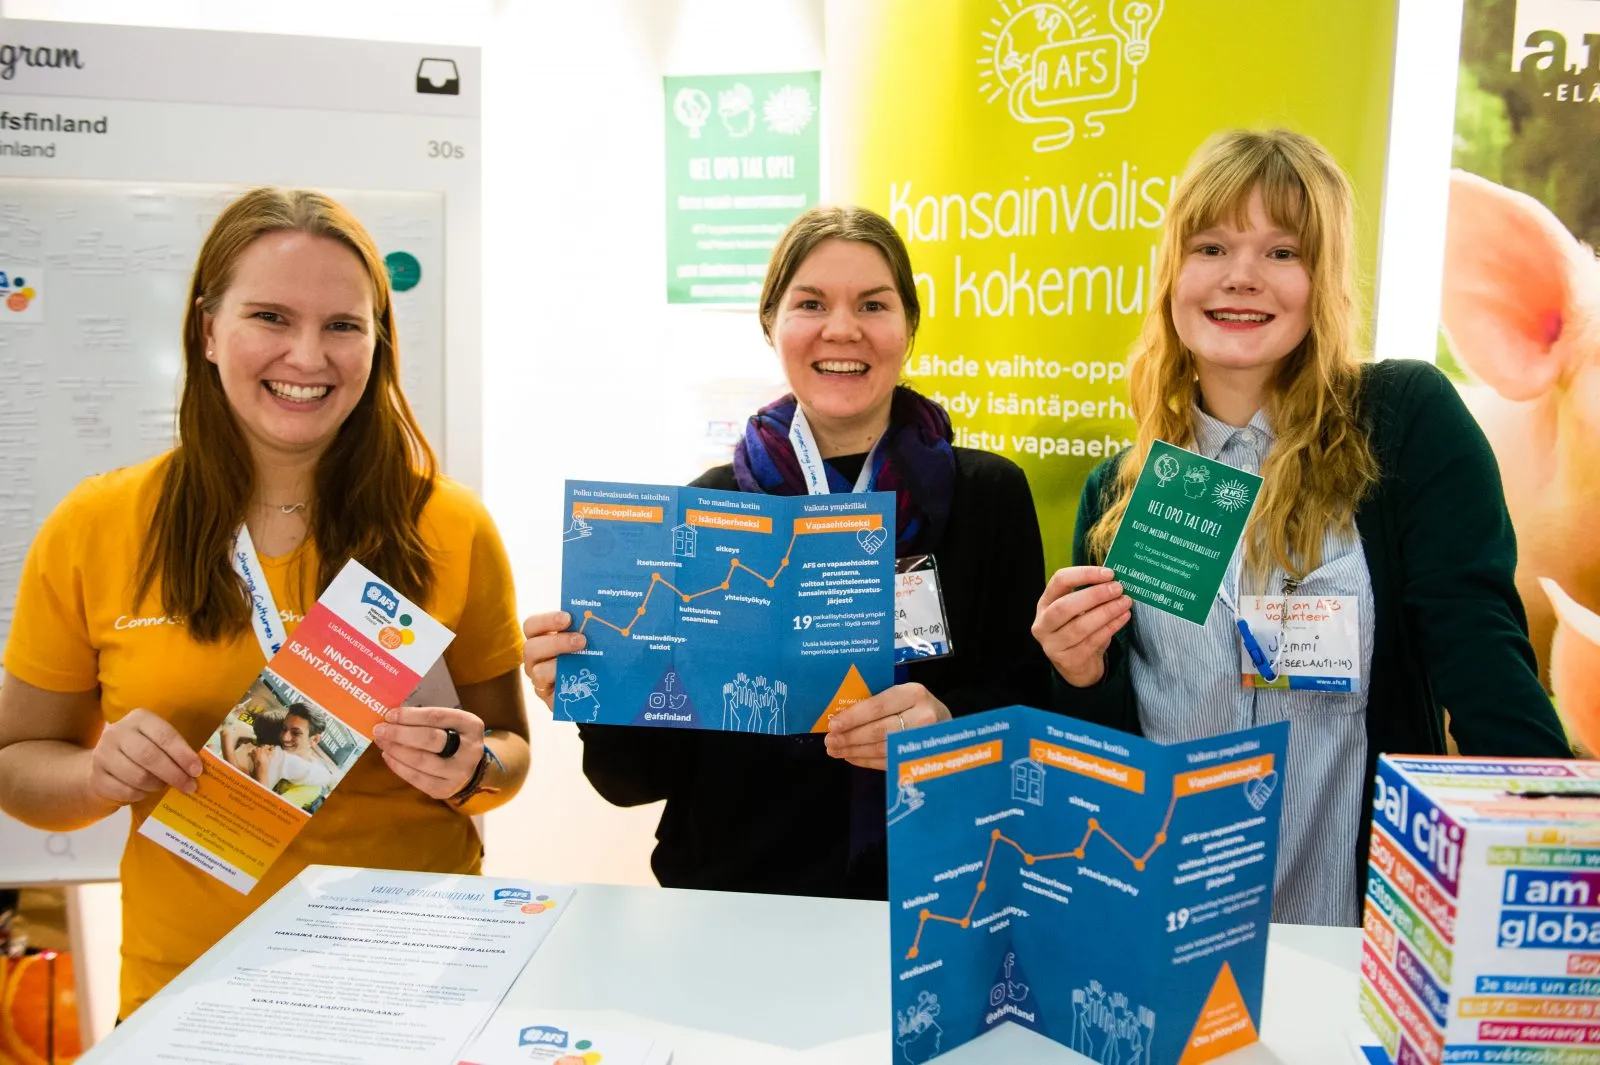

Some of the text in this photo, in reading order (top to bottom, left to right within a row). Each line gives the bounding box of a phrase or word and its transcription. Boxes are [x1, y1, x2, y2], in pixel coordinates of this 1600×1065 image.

[0, 44, 85, 80] gram
[1053, 48, 1108, 89] AFS
[0, 111, 108, 134] fsfinland
[427, 140, 465, 159] 30s
[888, 160, 1177, 243] Kansainvälis
[905, 355, 980, 377] Lähde
[573, 489, 670, 501] Polku tulevaisuuden taitoihin
[1229, 490, 1242, 498] AFS
[698, 497, 761, 511] Tuo maailma kotiin
[804, 502, 867, 512] Vaikuta ympärilläsi
[582, 506, 653, 519] Vaihto-oppilaaksi
[1147, 499, 1222, 539] HEI OPO TAI OPE!
[805, 519, 871, 531] Vapaaehtoiseksi
[715, 545, 740, 554] sitkeys
[636, 558, 683, 569] itsetuntemus
[803, 561, 816, 569] AFS
[826, 559, 879, 569] vapaaehtoisten
[800, 577, 880, 588] voittoa tavoittelematon
[236, 552, 274, 640] Sharing Cultures
[597, 588, 643, 598] analyyttisyys
[798, 586, 883, 598] kansainvälisyyskasvatus-
[377, 595, 396, 611] AFS
[570, 598, 601, 607] kielitaito
[724, 593, 772, 606] yhteistyökyky
[826, 596, 853, 606] järjestö
[1255, 599, 1342, 611] I am an AFS
[679, 605, 721, 616] kulttuurinen
[1265, 612, 1330, 622] volunteer
[681, 616, 719, 625] osaaminen
[793, 615, 813, 630] 19
[815, 621, 840, 629] Suomen
[632, 633, 688, 644] kansainvälisyys-
[649, 643, 671, 651] taidot
[322, 644, 374, 685] INNOSTU
[372, 655, 399, 677] ARKEEN
[644, 711, 692, 722] @afsfinland
[1046, 725, 1065, 737] Tuo
[910, 746, 992, 777] Vaihto-oppilaaksi
[1069, 795, 1100, 813] sitkeys
[1019, 867, 1073, 893] kulttuurinen
[1022, 882, 1070, 905] osaaminen
[1505, 873, 1590, 905] I am
[902, 892, 940, 910] kielitaito
[1165, 907, 1190, 933] 19
[900, 958, 943, 981] uteliaisuus
[1480, 978, 1566, 993] Je suis un
